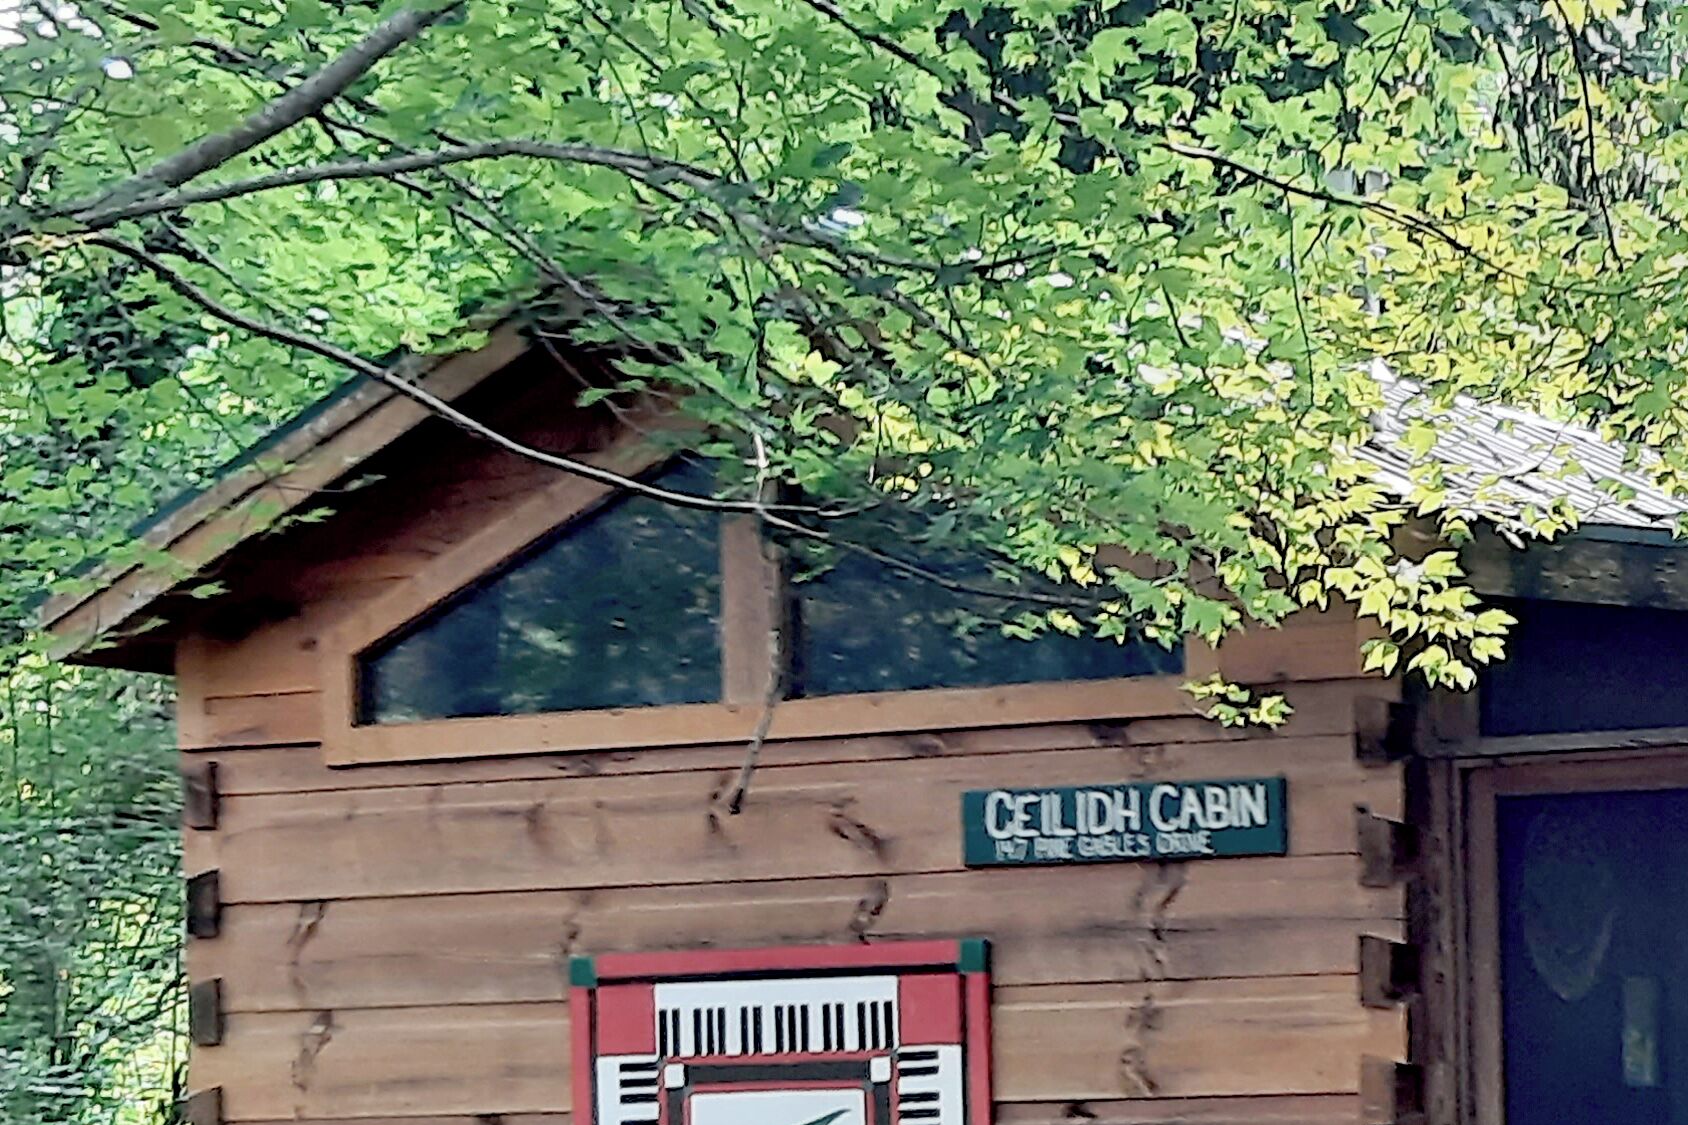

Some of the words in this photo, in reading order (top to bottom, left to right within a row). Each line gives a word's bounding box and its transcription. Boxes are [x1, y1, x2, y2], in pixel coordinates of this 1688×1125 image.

[985, 787, 1140, 838] CEILIDH
[1149, 782, 1269, 832] CABIN
[1155, 829, 1215, 855] DRIVE
